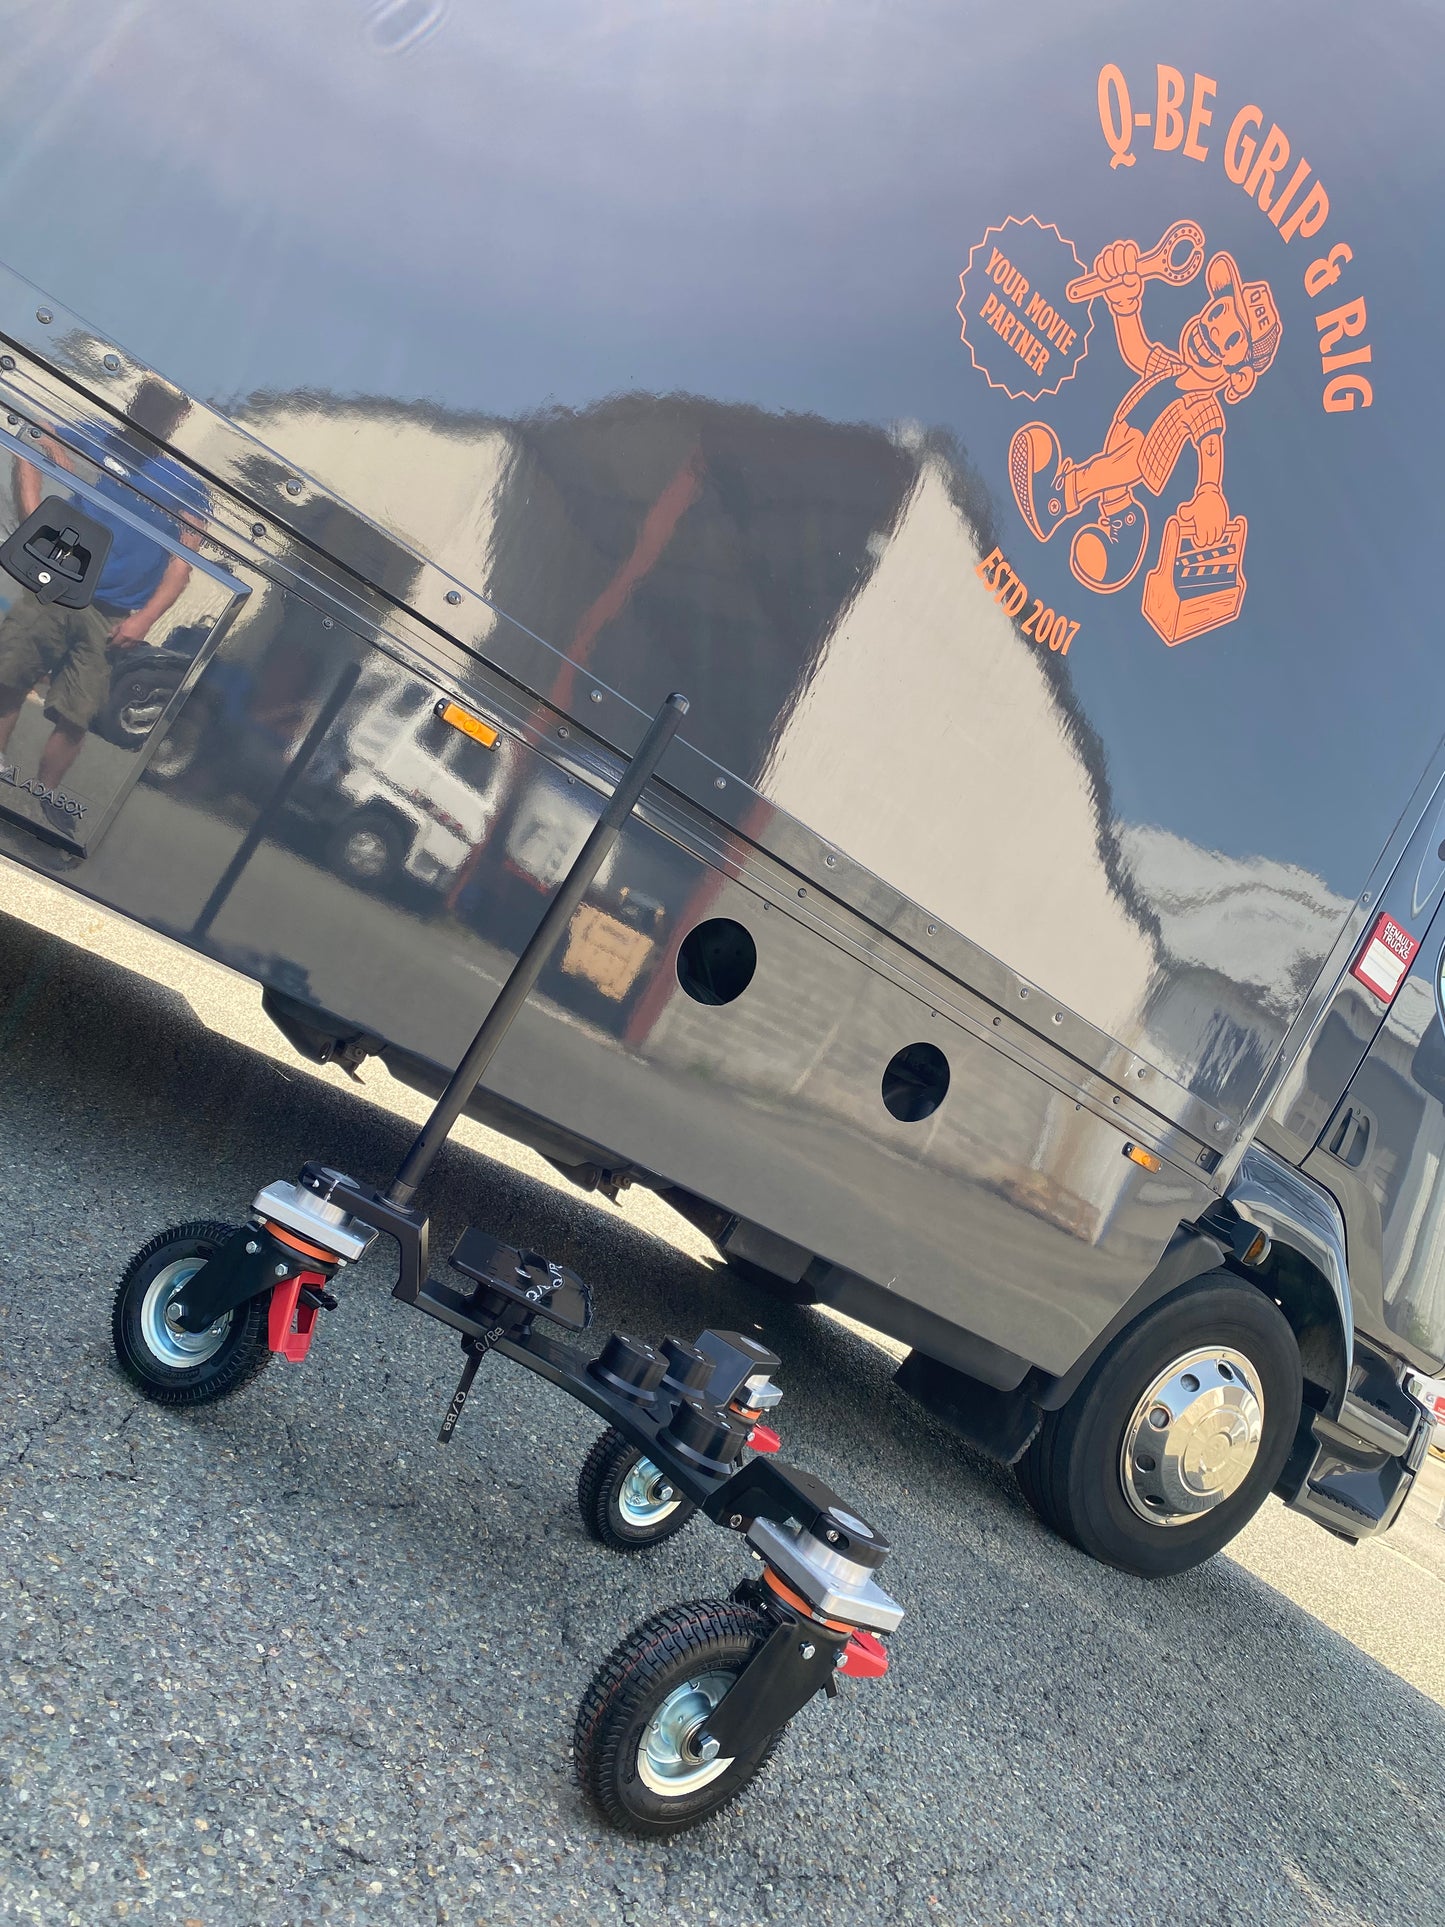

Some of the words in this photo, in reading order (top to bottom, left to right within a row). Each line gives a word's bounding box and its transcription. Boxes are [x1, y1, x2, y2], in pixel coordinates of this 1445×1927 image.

[1097, 63, 1217, 169] Q-BE
[1223, 104, 1330, 243] GRIP
[984, 247, 1030, 307] YOUR
[1024, 291, 1077, 355] MOVIE
[1303, 242, 1353, 297] &
[979, 292, 1050, 376] PARTNER
[1249, 289, 1270, 331] Q/BE
[1315, 296, 1374, 413] RIG
[974, 546, 1028, 618] ESTD
[1020, 598, 1081, 656] 2007
[19, 778, 88, 820] ADABOX
[1382, 930, 1410, 960] TRUCKS
[1385, 921, 1415, 951] RENAULT
[474, 1326, 505, 1353] Q/Be
